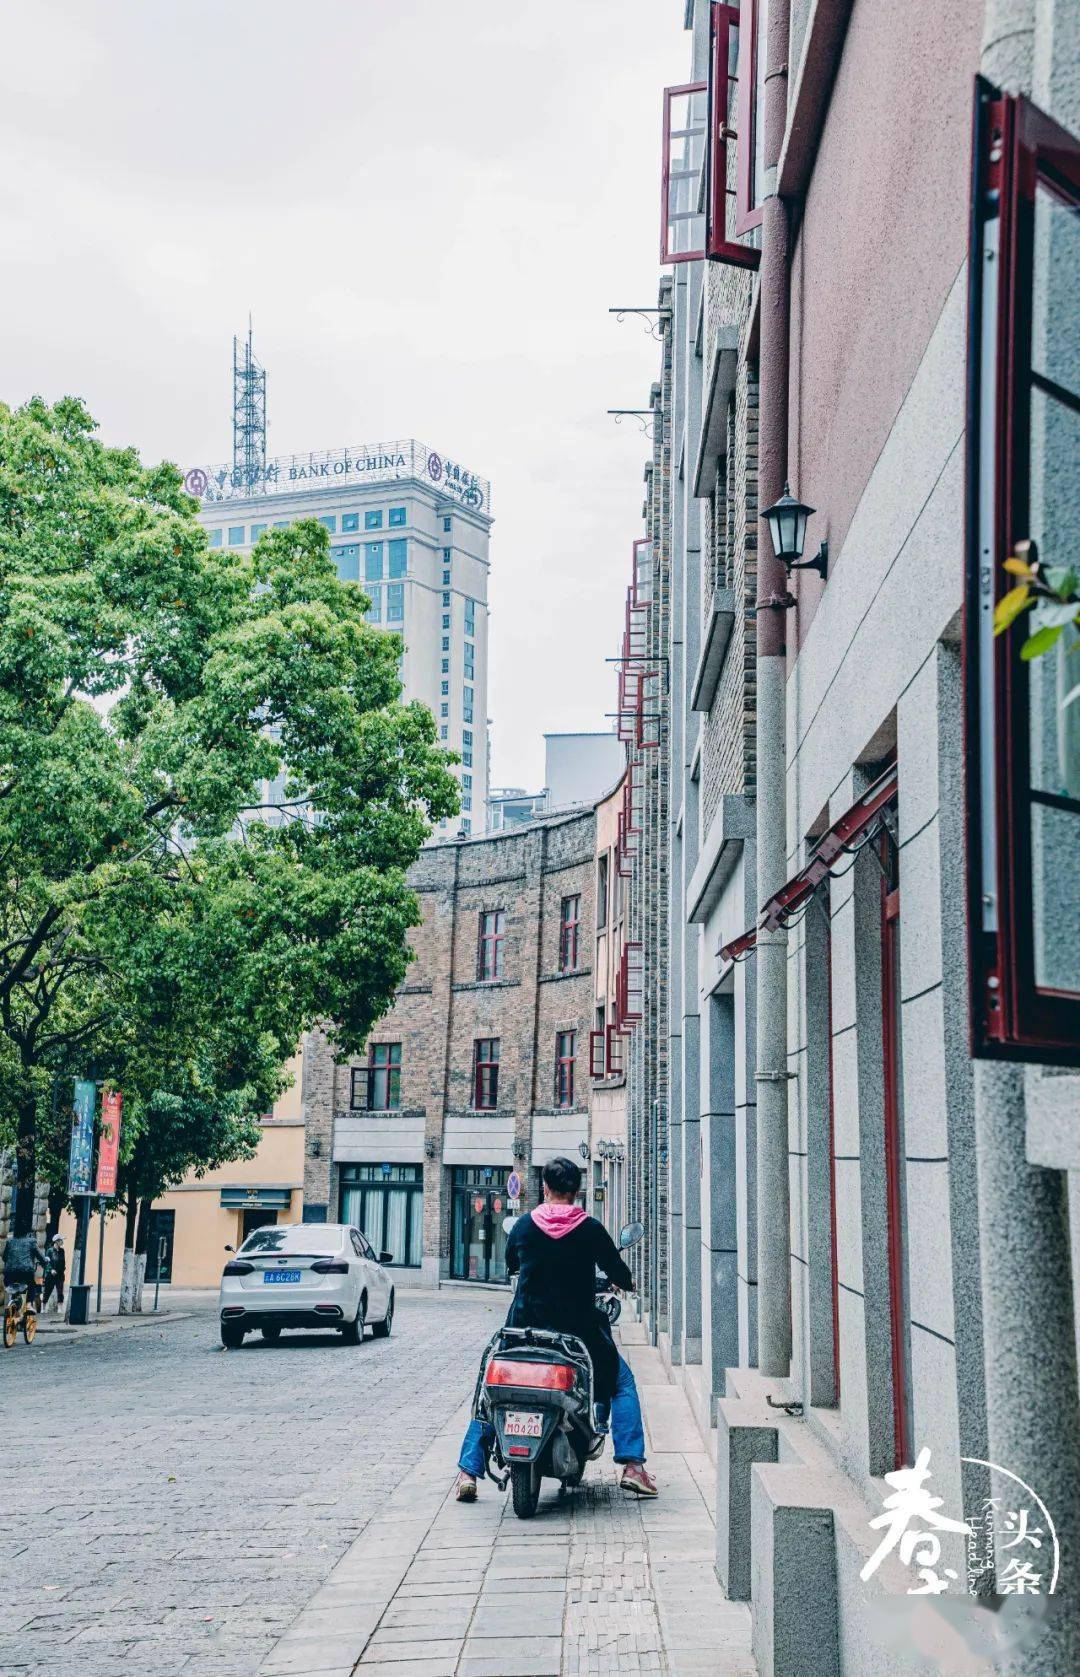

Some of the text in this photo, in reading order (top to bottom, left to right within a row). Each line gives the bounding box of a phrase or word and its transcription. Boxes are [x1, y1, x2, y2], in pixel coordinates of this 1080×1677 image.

[289, 454, 406, 480] BANK OF CHINA
[506, 1423, 540, 1435] M0420
